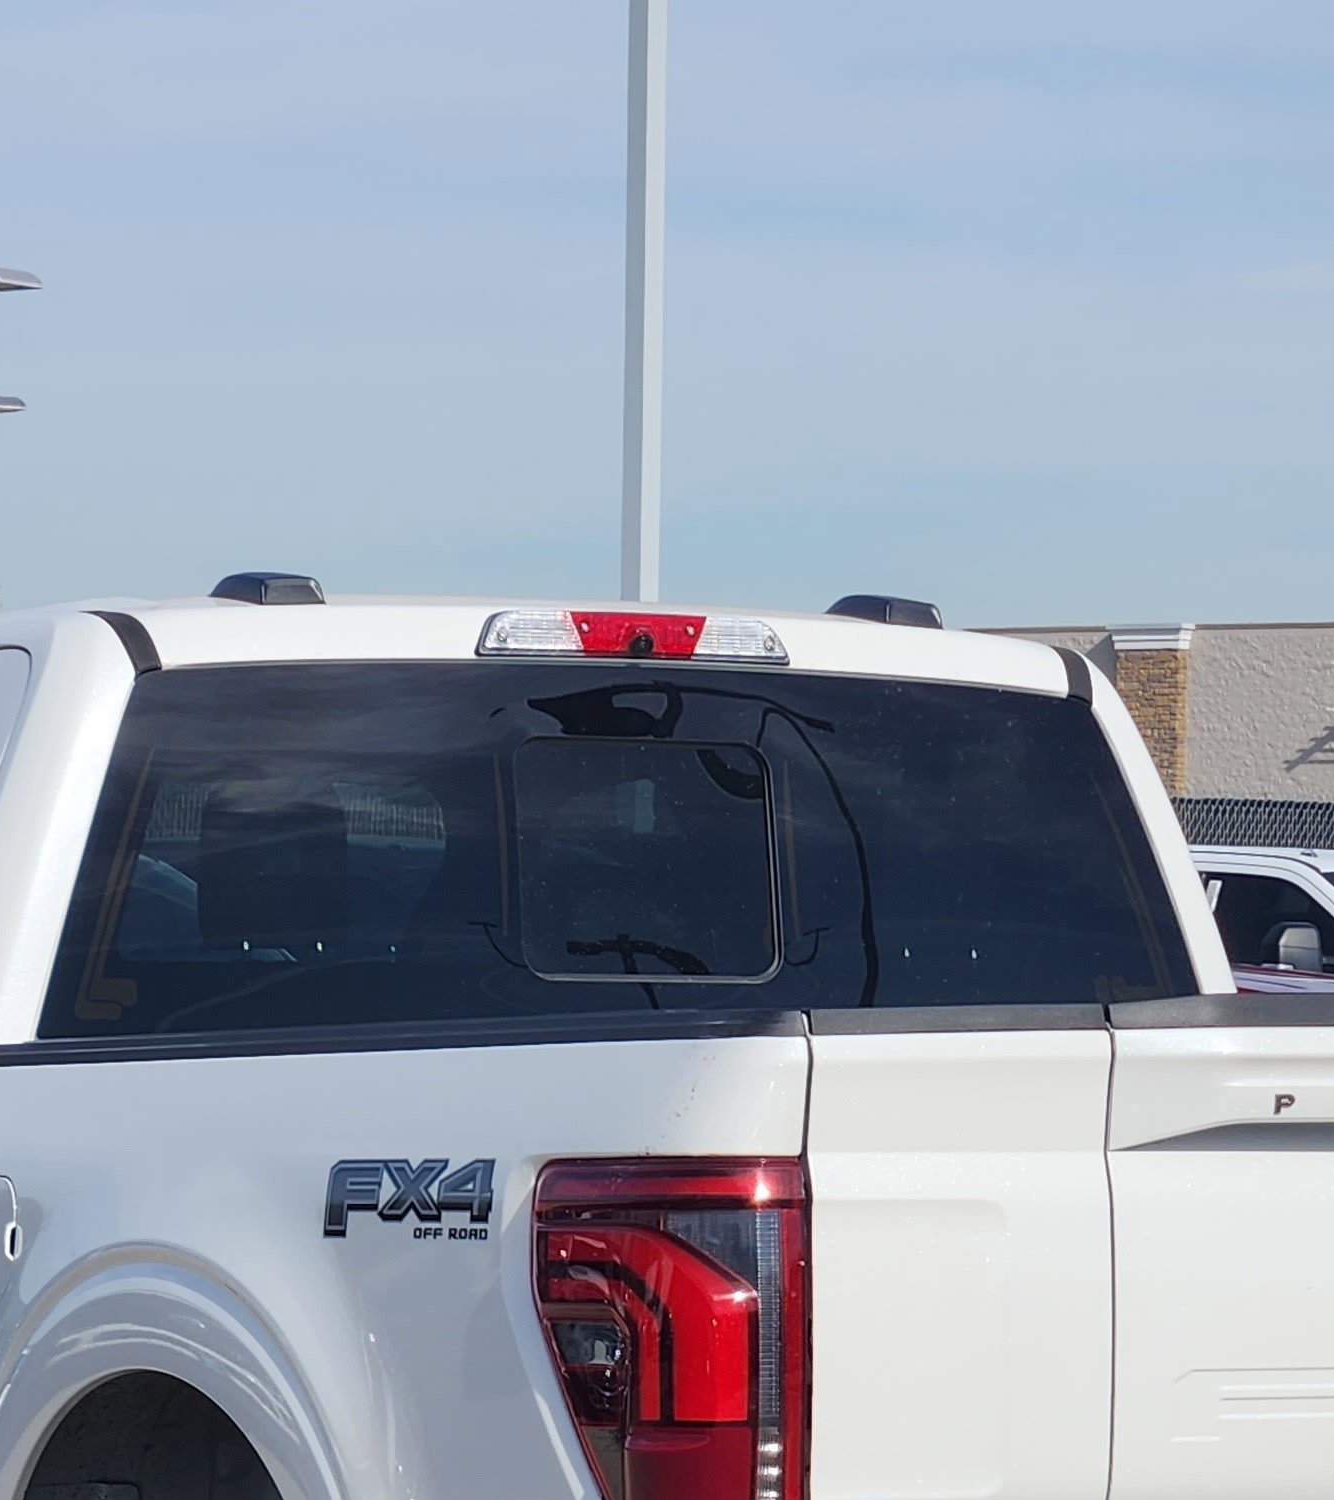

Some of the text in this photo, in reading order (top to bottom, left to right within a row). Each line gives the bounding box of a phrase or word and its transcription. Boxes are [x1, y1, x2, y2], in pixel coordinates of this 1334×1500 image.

[323, 1158, 496, 1239] FX4
[413, 1227, 489, 1241] OFF ROAD
